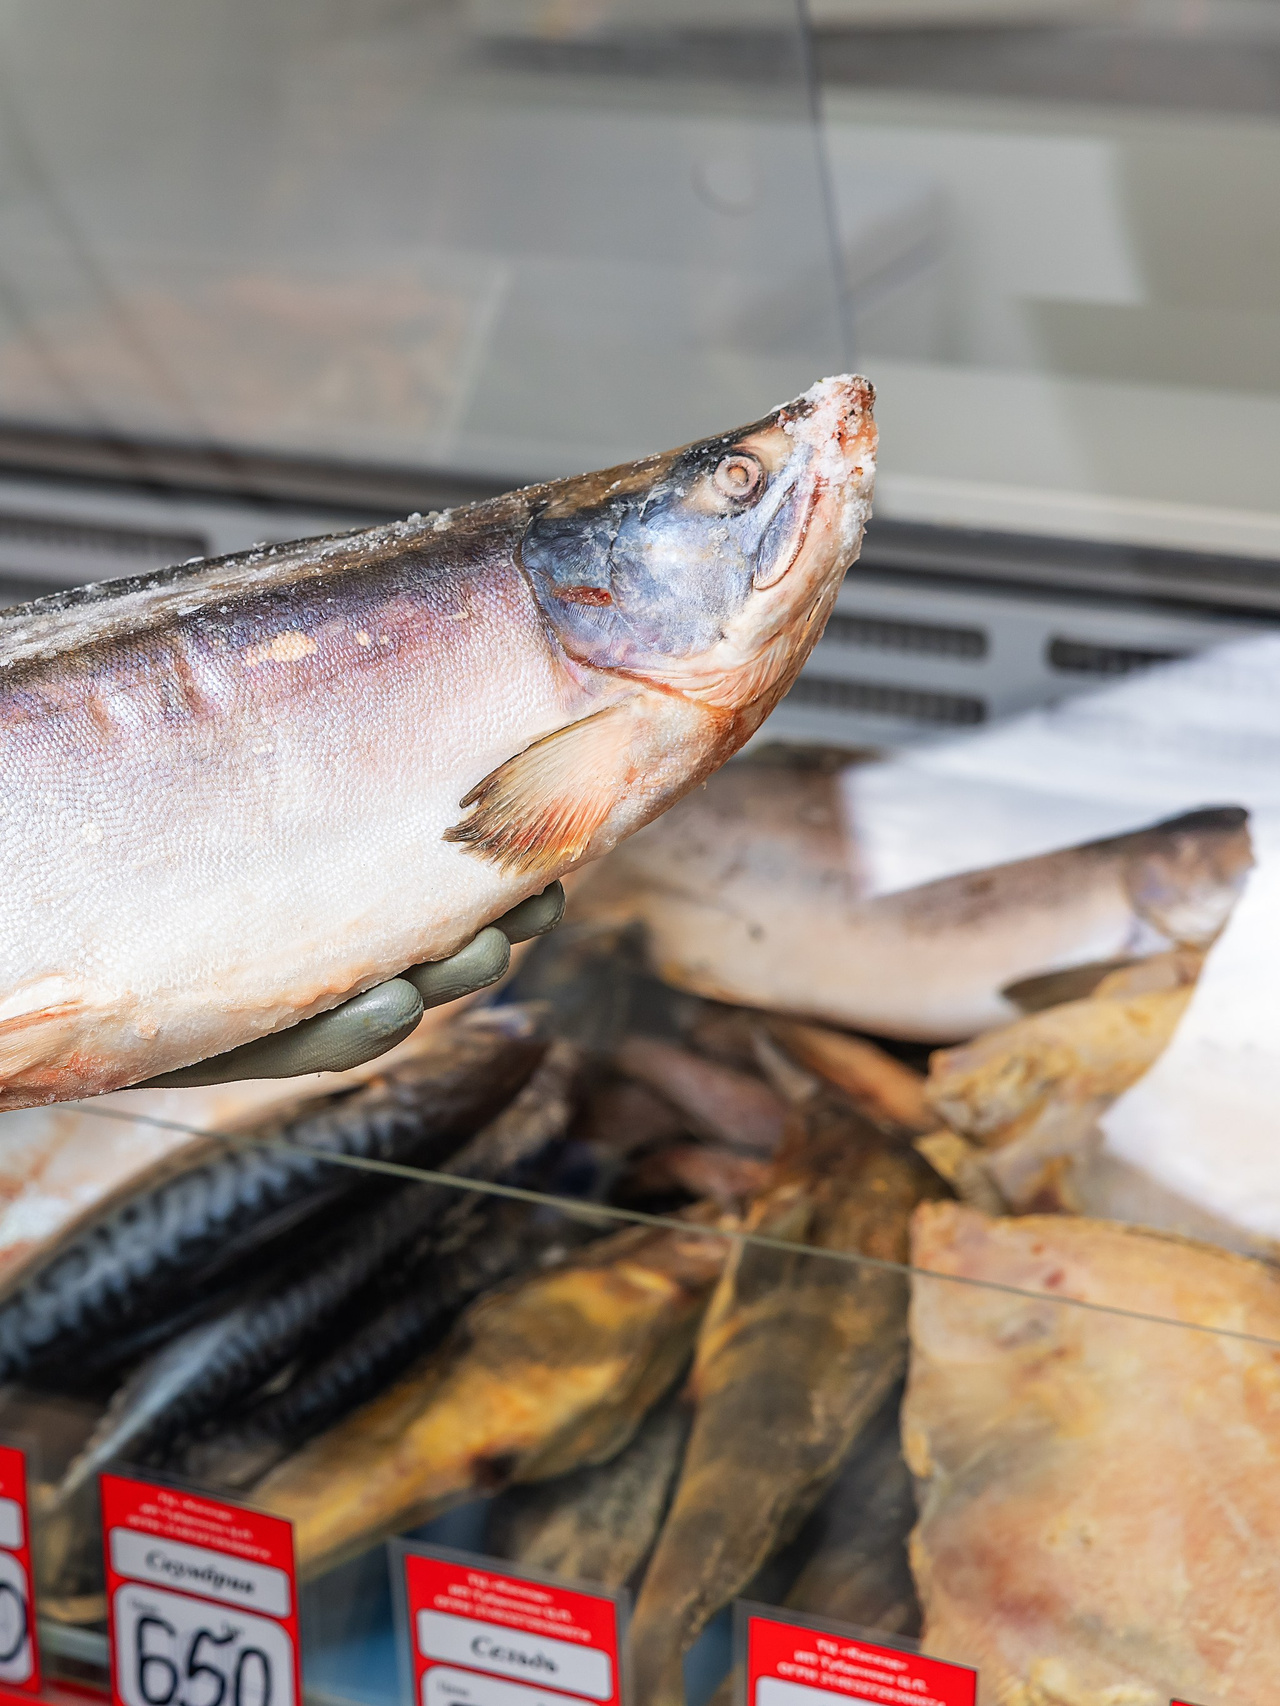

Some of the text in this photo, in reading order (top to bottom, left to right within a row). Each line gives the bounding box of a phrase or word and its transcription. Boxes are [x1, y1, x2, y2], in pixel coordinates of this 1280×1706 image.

[145, 1550, 256, 1593] Скумбрия
[135, 1615, 272, 1706] 650
[470, 1634, 559, 1674] Сельдь
